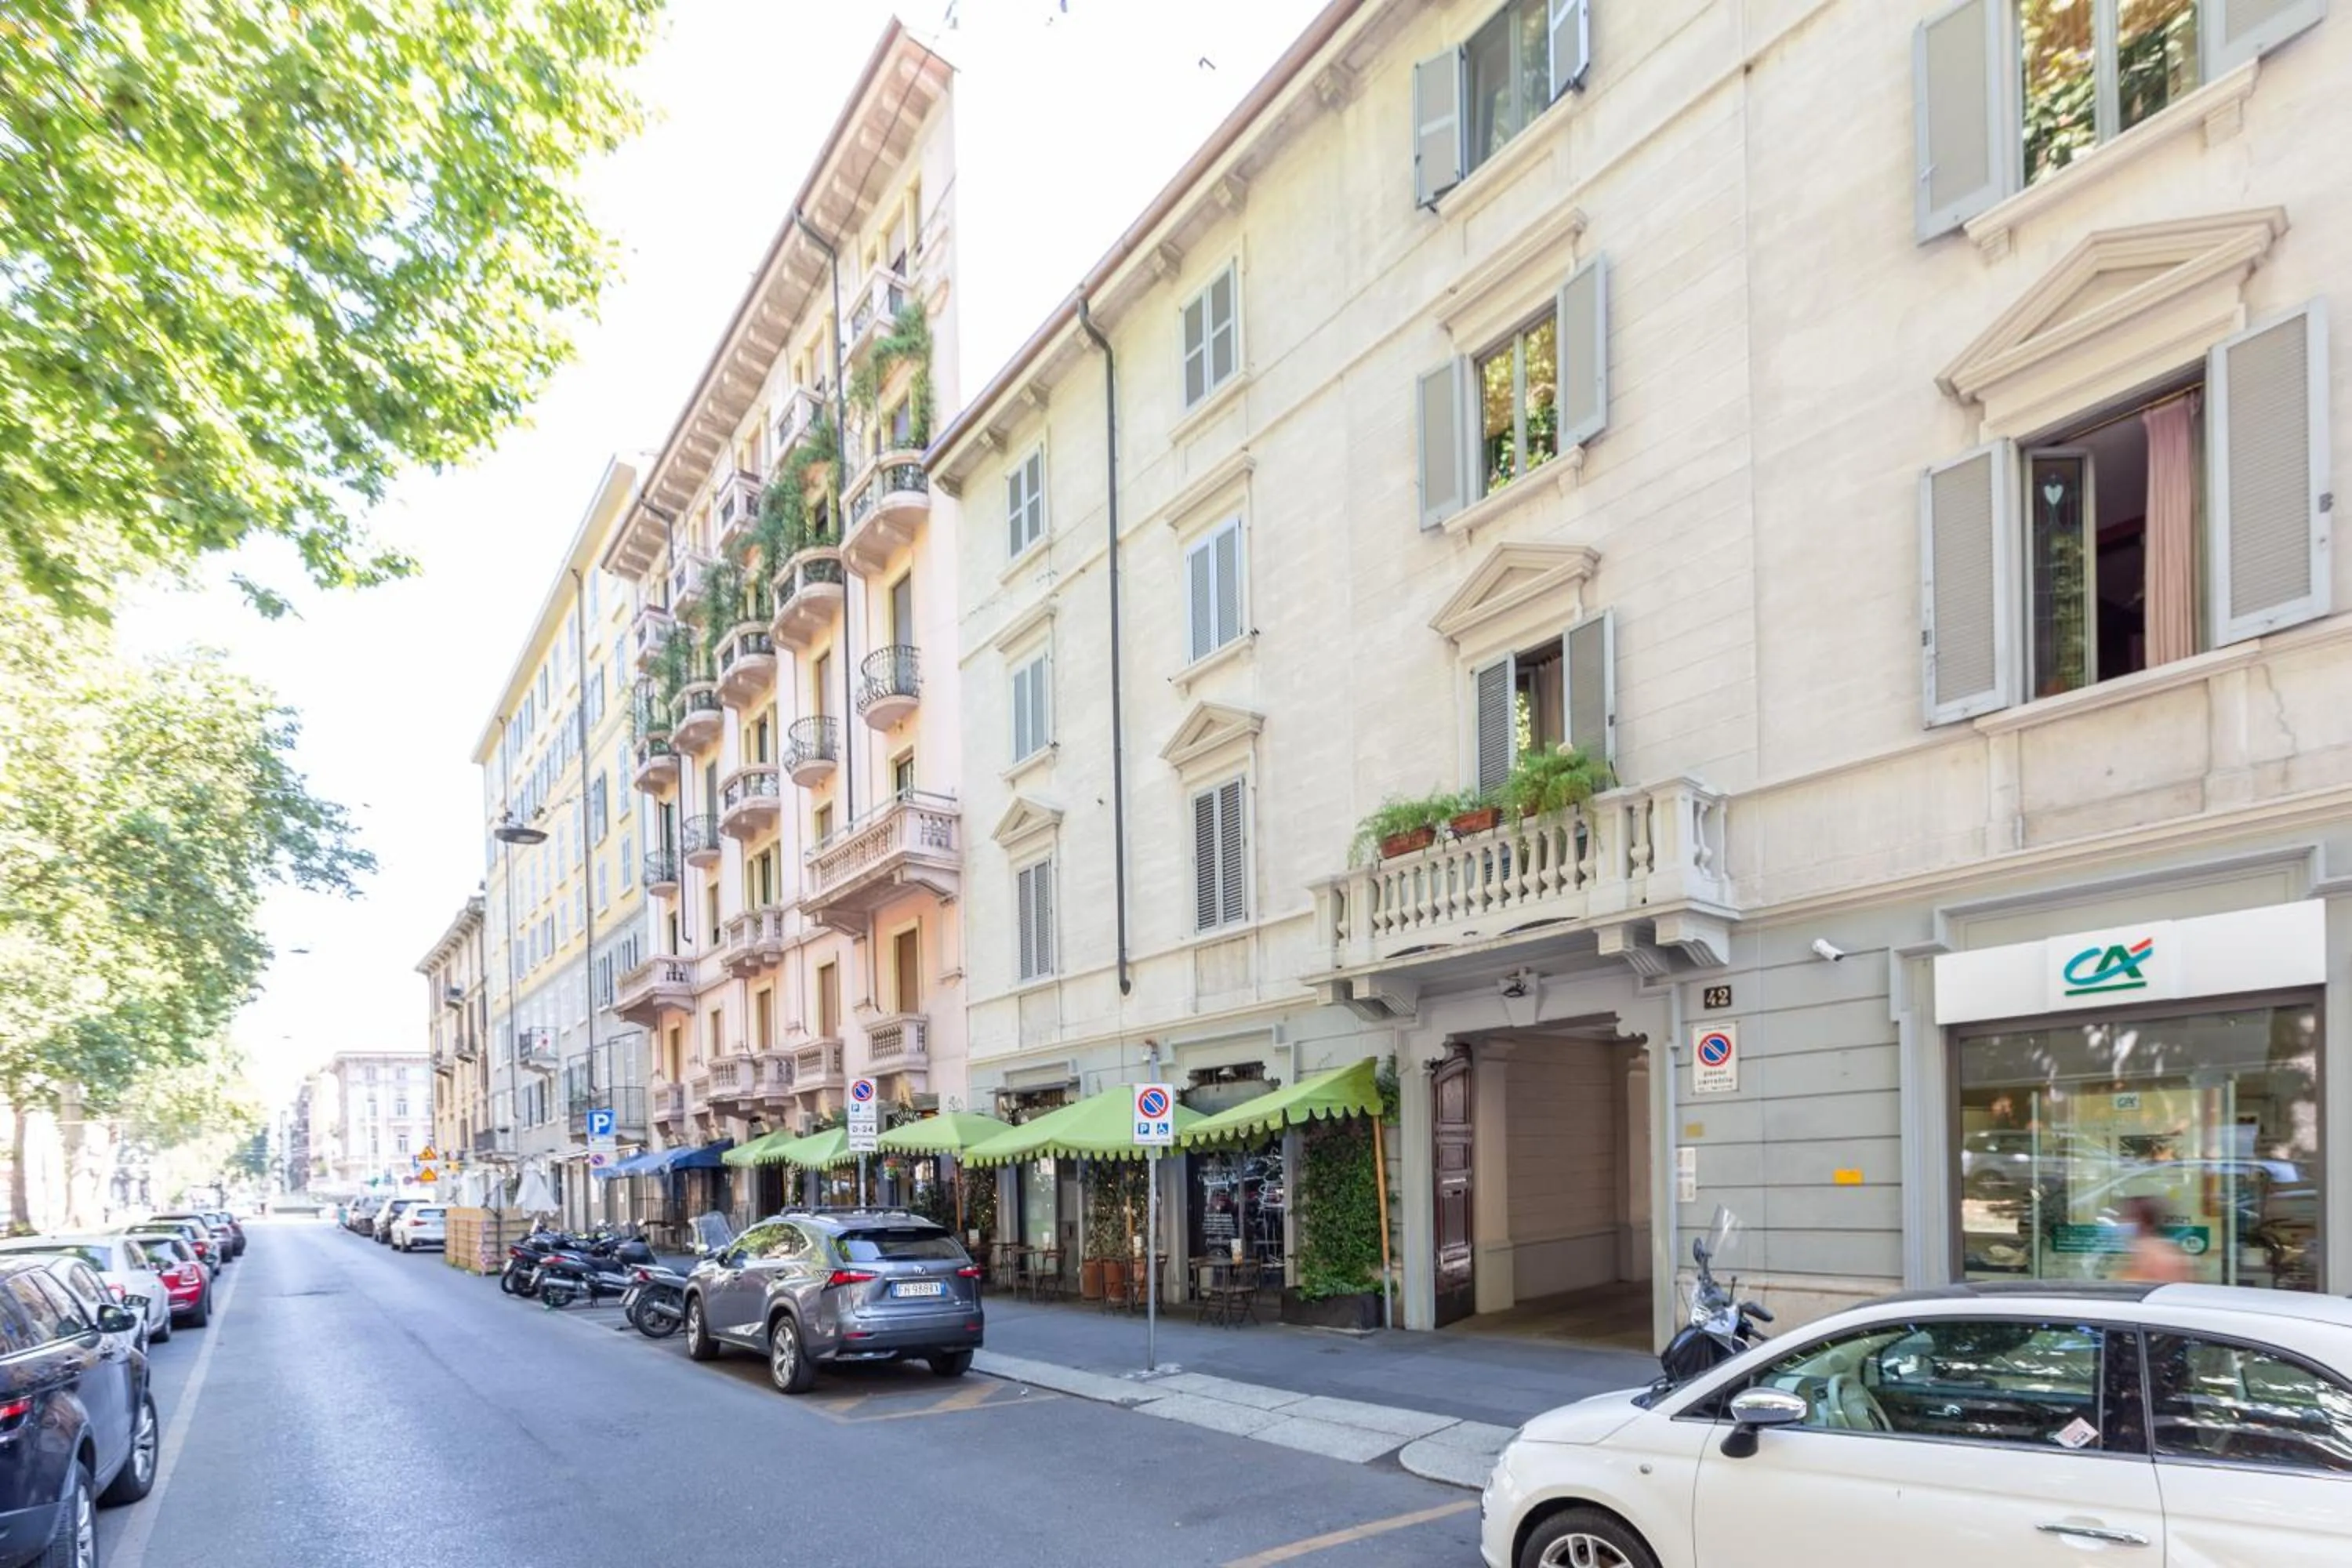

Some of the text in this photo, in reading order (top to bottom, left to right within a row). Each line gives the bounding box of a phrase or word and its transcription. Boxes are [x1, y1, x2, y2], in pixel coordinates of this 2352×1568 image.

[2063, 939, 2153, 987] CA
[1706, 988, 1730, 1006] 42
[593, 1114, 609, 1133] P
